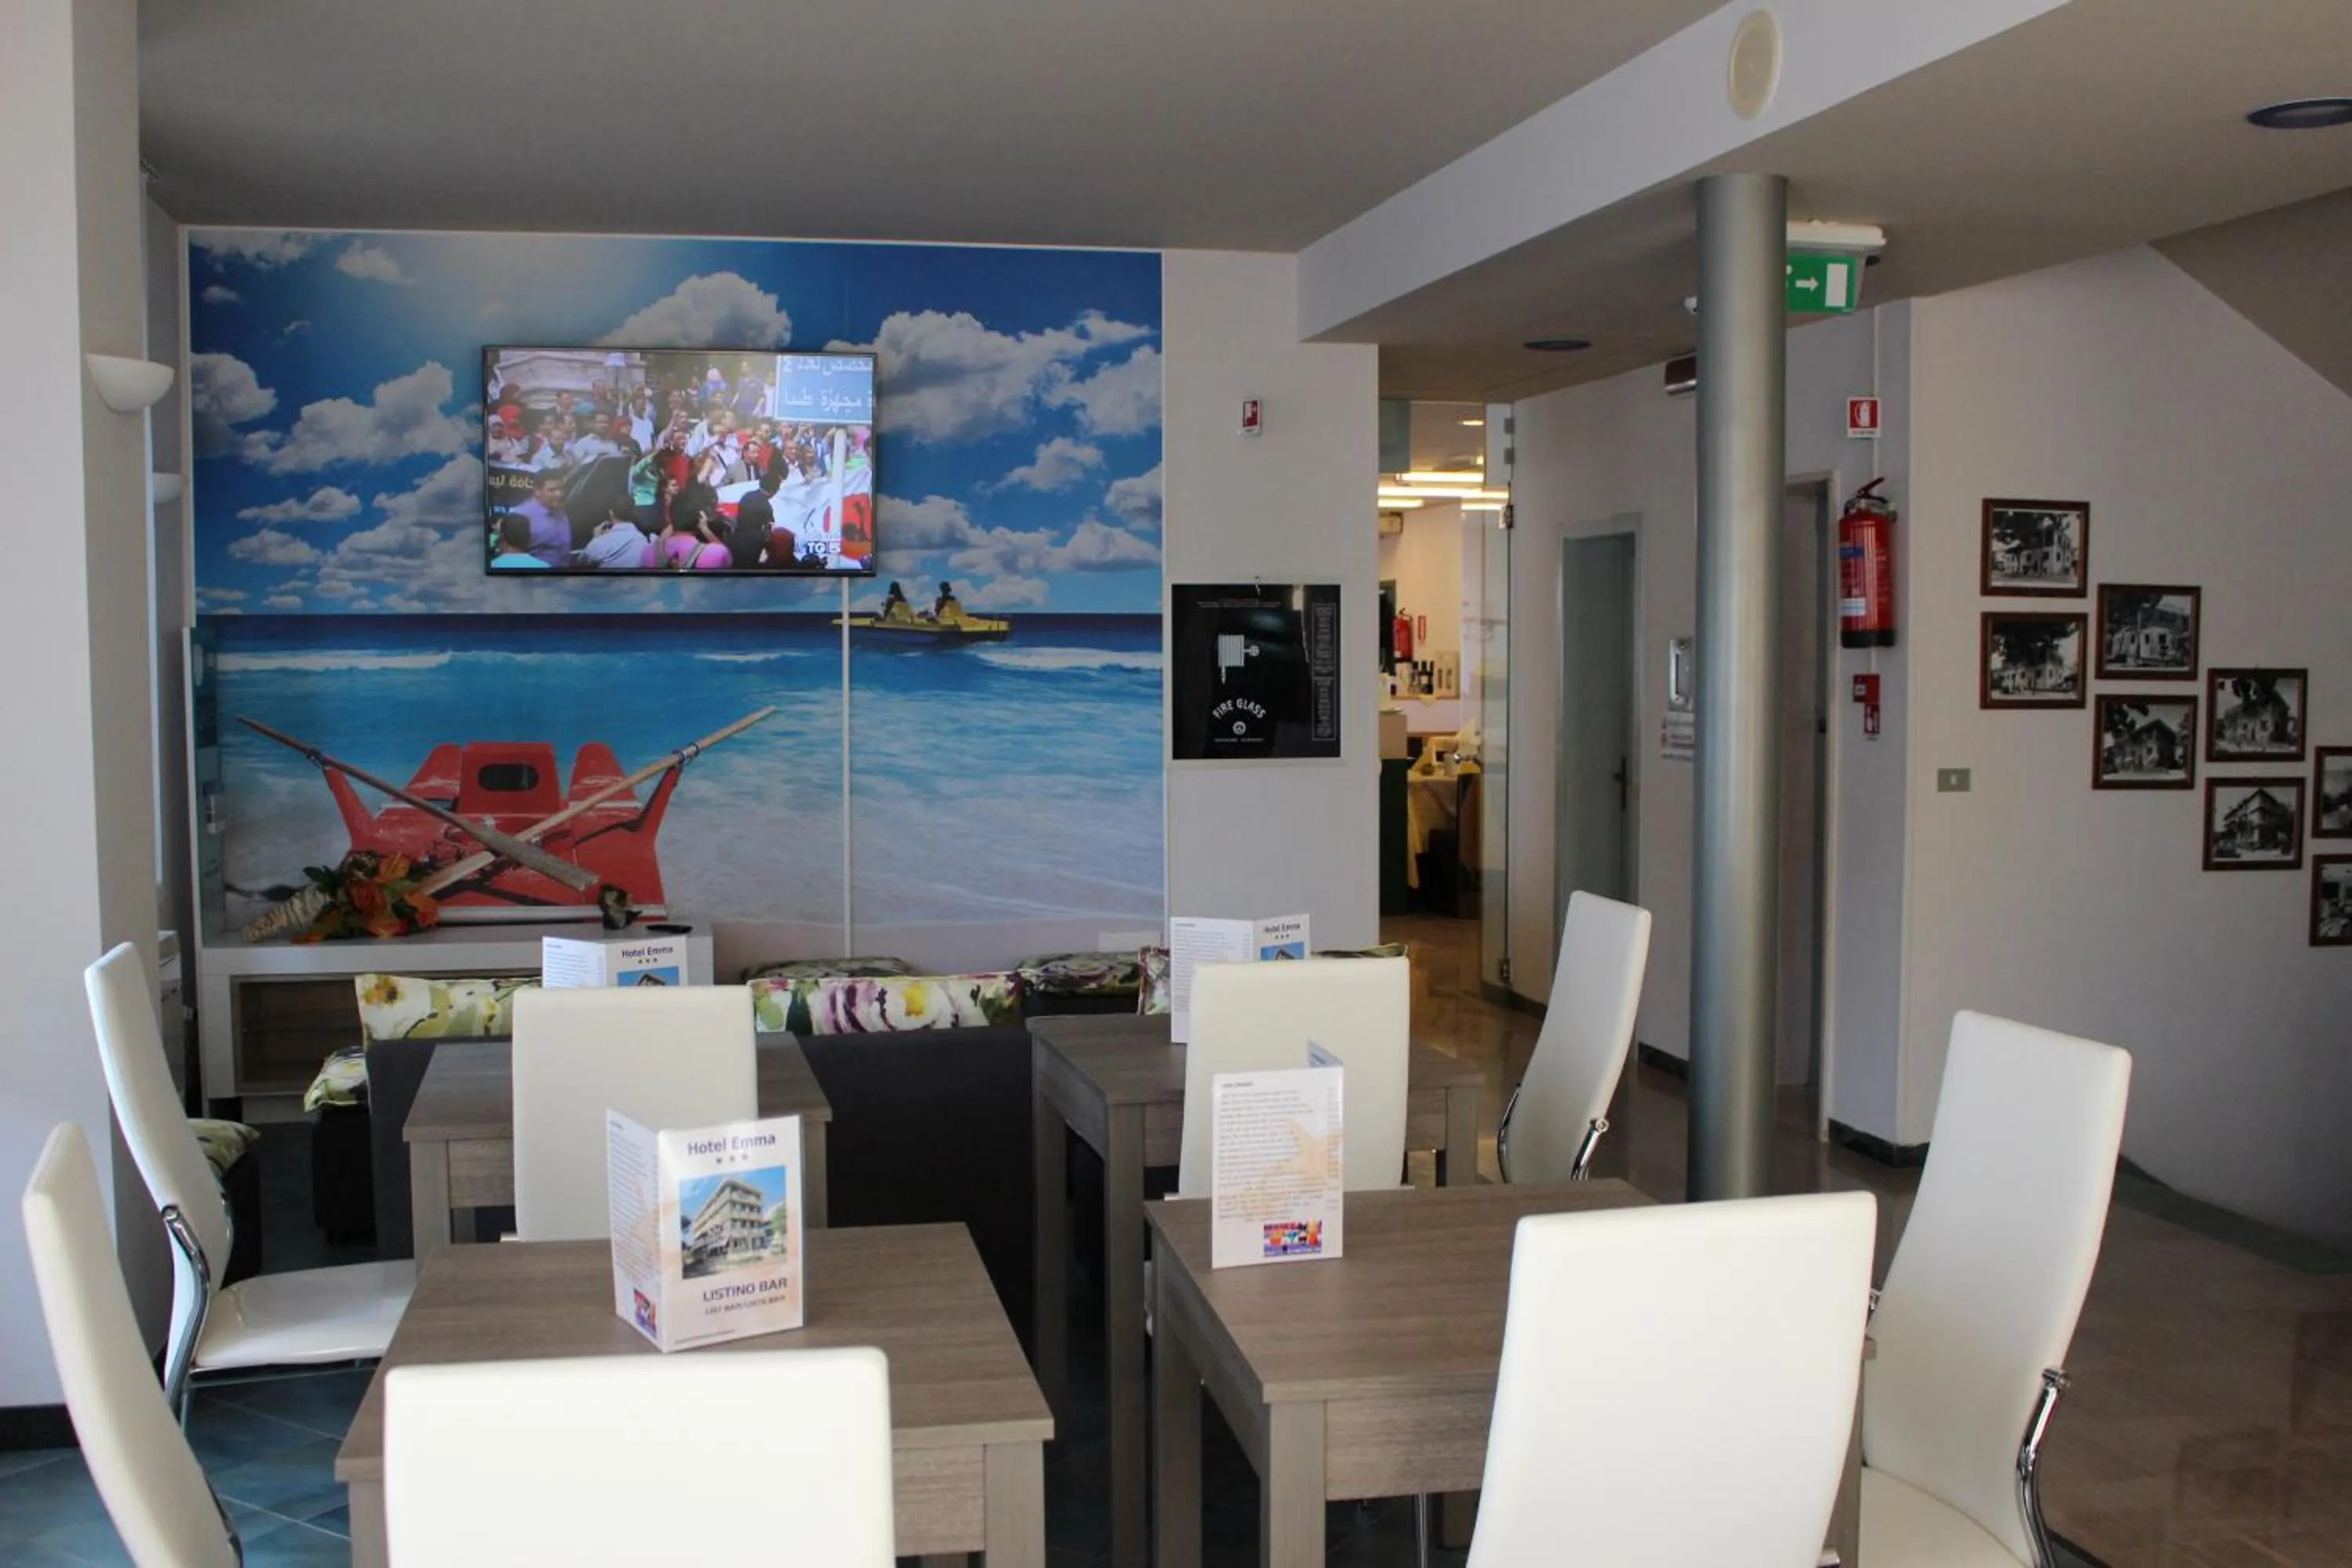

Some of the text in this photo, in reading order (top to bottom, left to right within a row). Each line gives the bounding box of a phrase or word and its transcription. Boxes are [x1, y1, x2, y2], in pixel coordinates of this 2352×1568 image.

[1212, 698, 1267, 720] FIRE GLASS
[622, 946, 674, 958] Hotel Emma
[688, 1134, 776, 1155] Hotel Emma
[702, 1277, 788, 1302] LISTINO BAR
